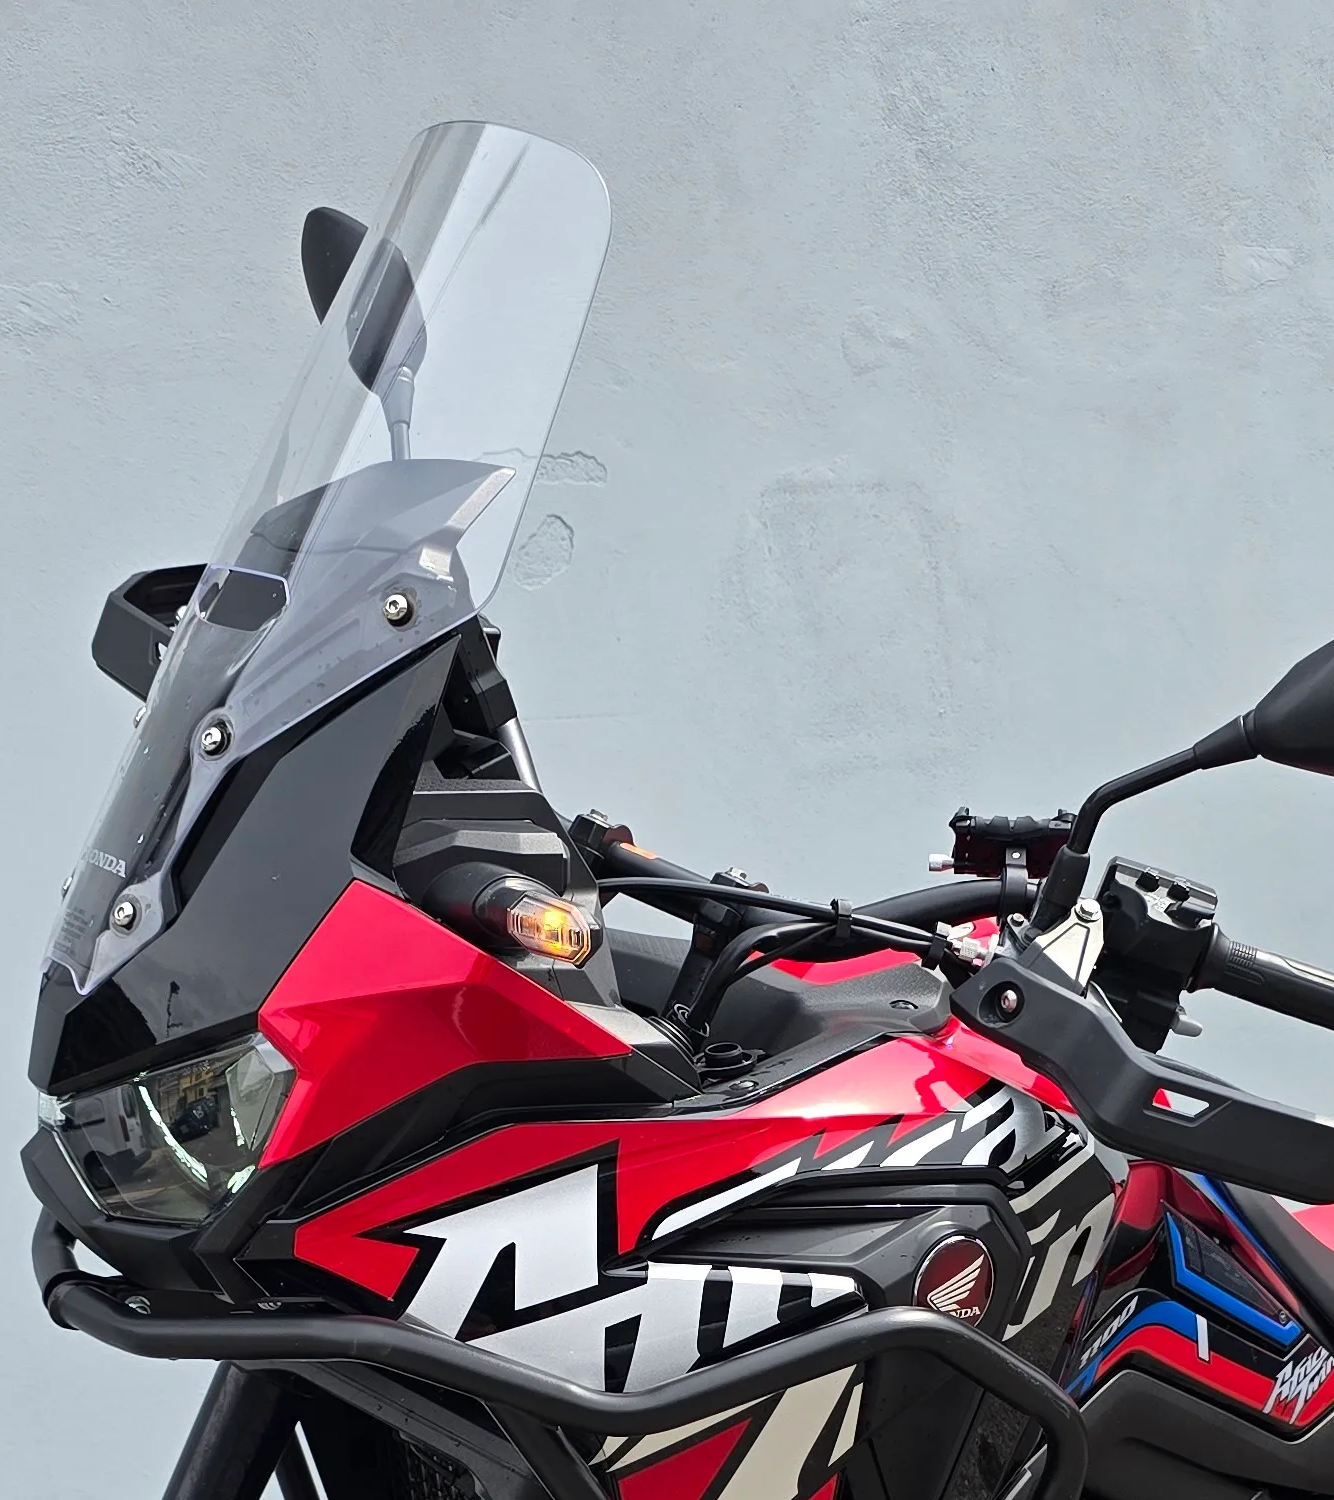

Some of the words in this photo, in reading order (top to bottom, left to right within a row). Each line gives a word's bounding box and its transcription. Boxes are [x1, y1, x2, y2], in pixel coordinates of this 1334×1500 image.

[948, 1306, 981, 1319] NDA
[1079, 1295, 1139, 1370] 1100
[1262, 1345, 1329, 1414] Afric
